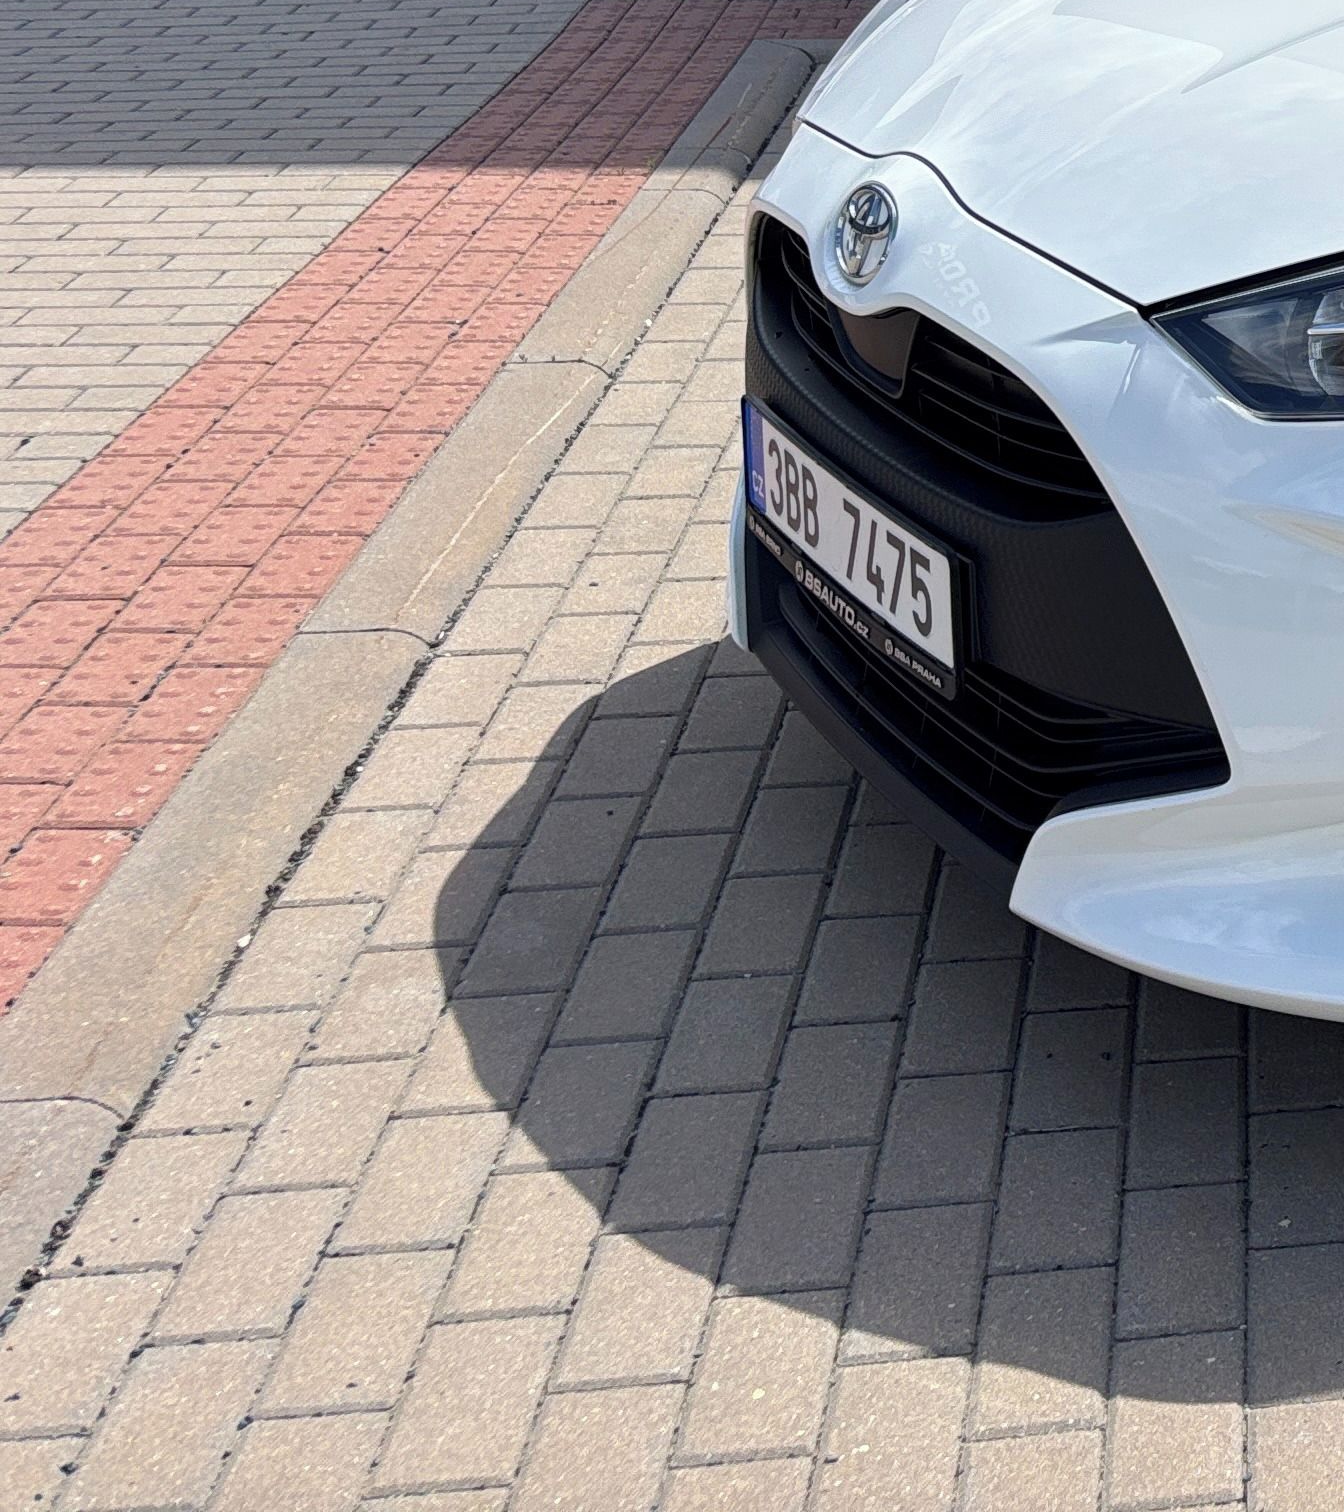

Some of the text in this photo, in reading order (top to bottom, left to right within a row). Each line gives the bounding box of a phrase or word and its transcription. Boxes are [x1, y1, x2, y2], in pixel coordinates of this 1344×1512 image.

[752, 470, 765, 498] CZ
[768, 439, 932, 638] 3BB 7475
